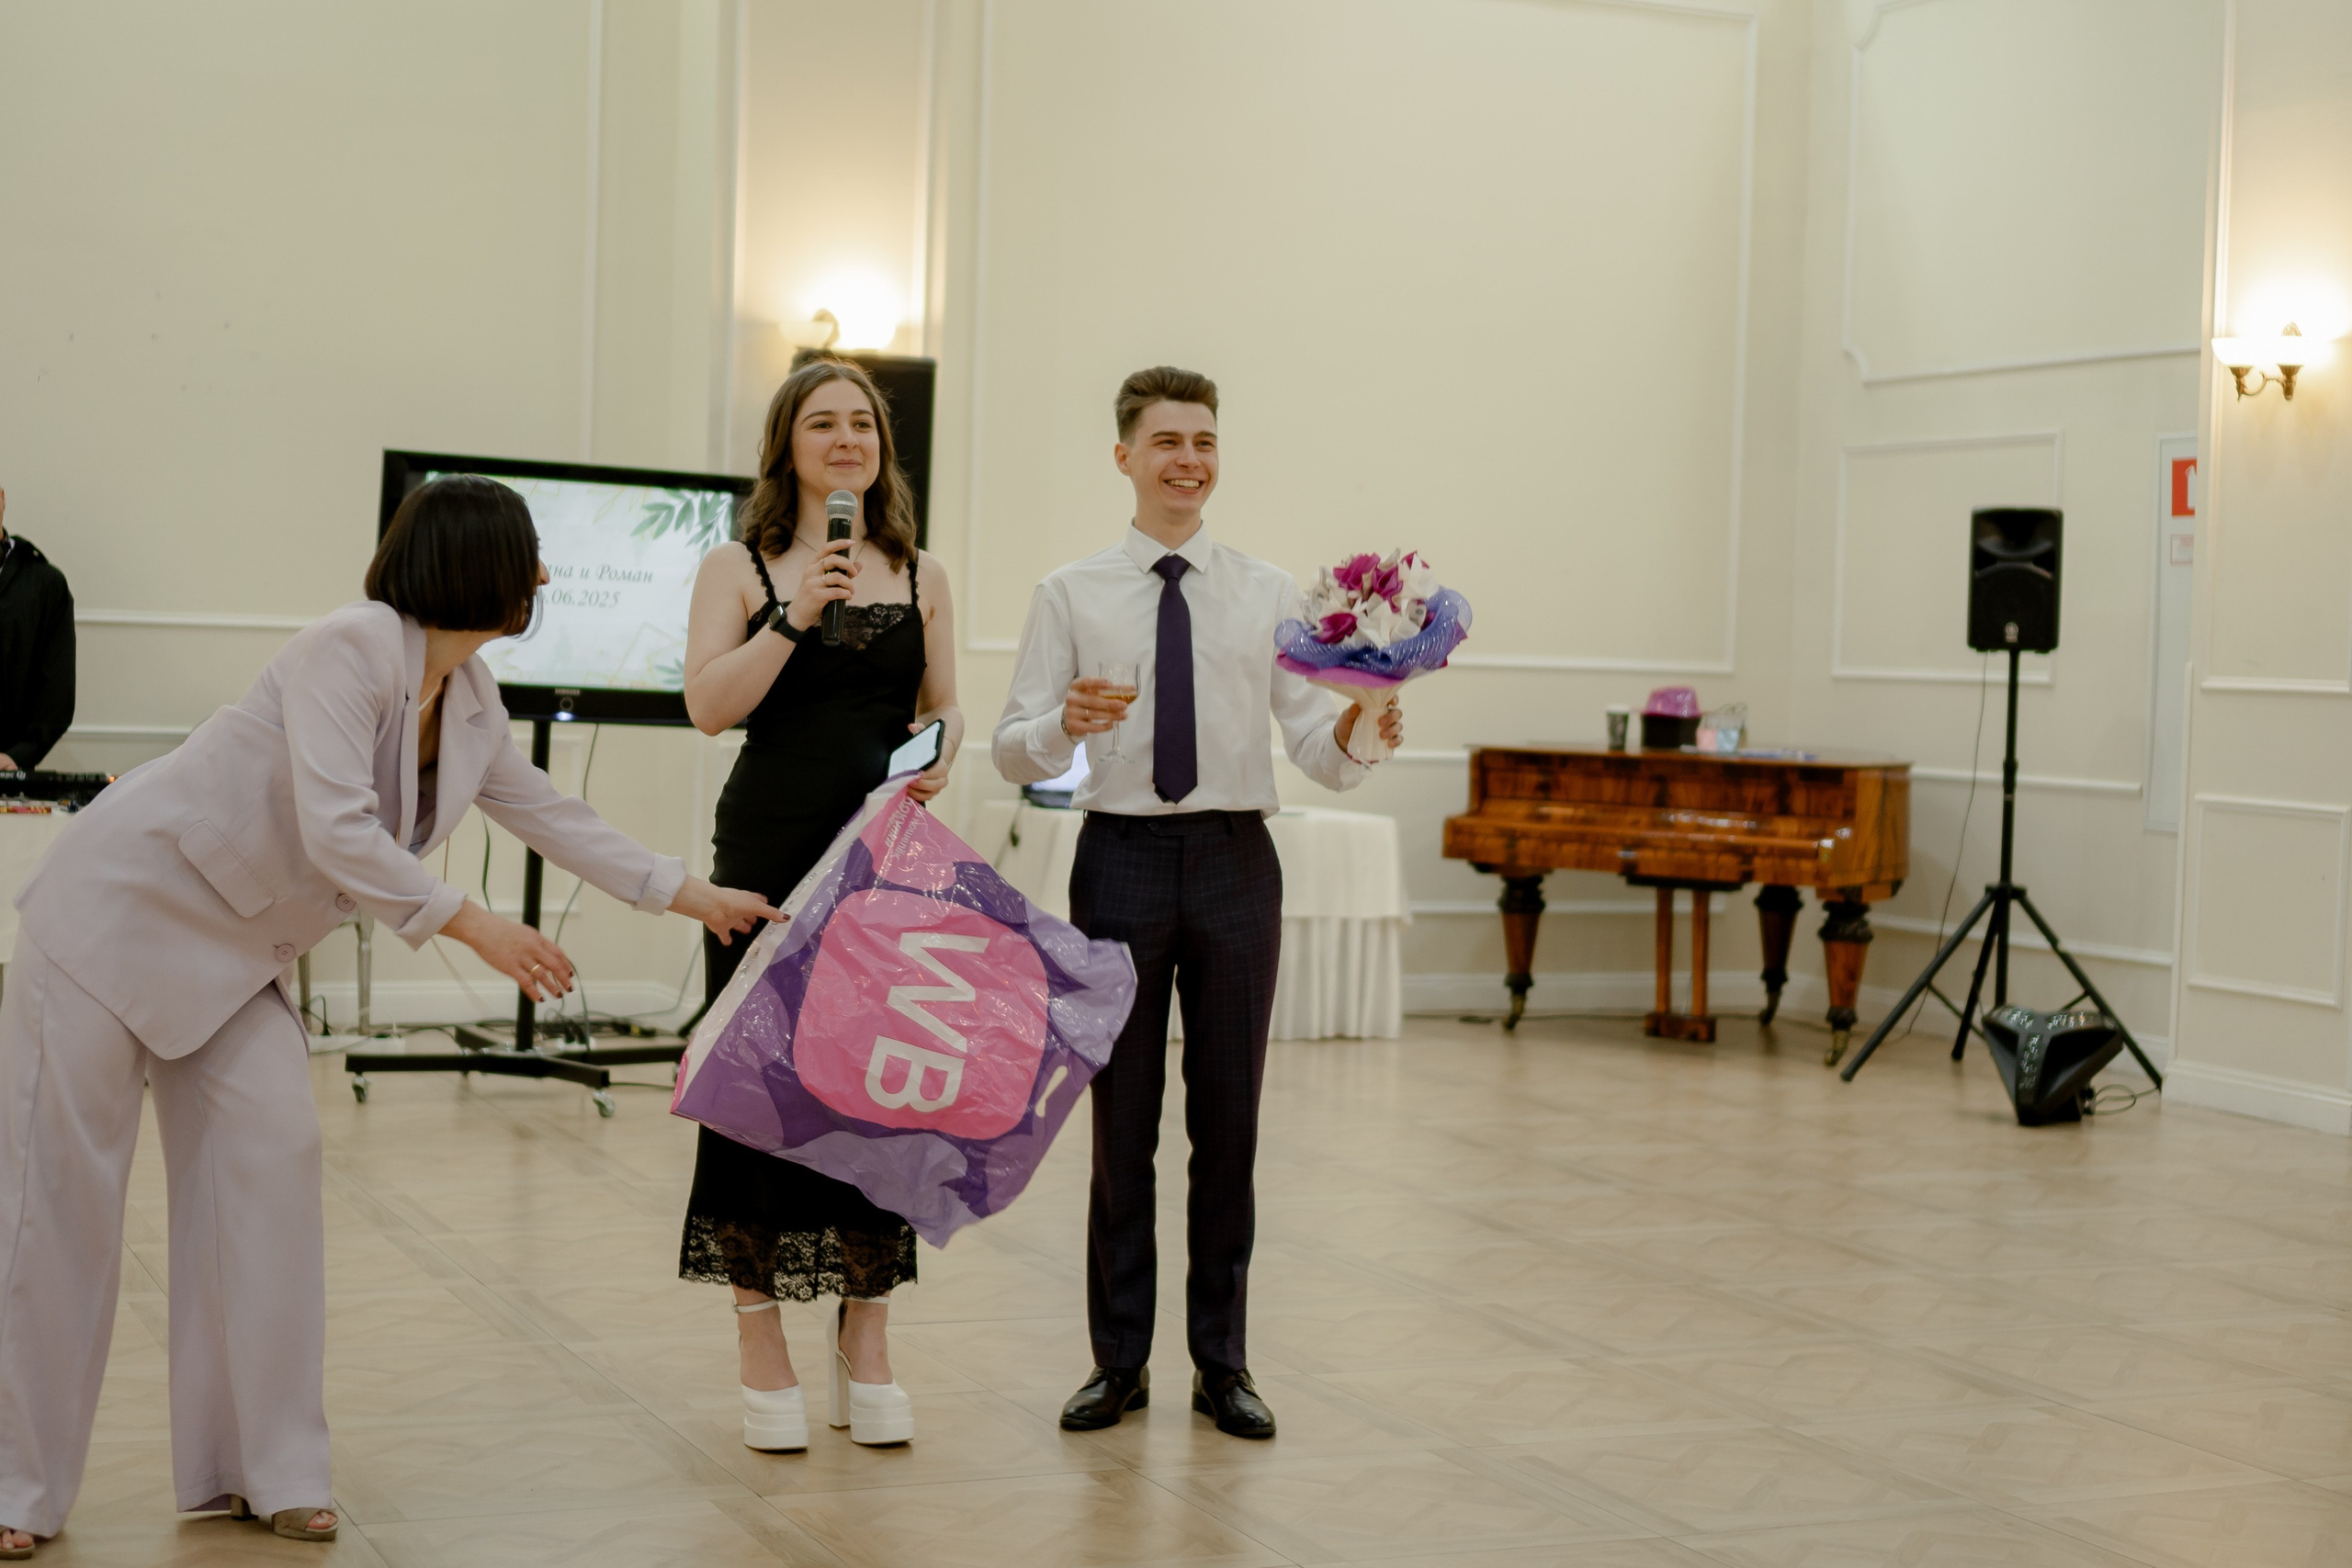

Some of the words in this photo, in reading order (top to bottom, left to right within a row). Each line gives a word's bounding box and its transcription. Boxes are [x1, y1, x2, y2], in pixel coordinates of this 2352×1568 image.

[579, 565, 590, 580] и
[595, 563, 653, 583] Роман
[865, 931, 990, 1113] WB
